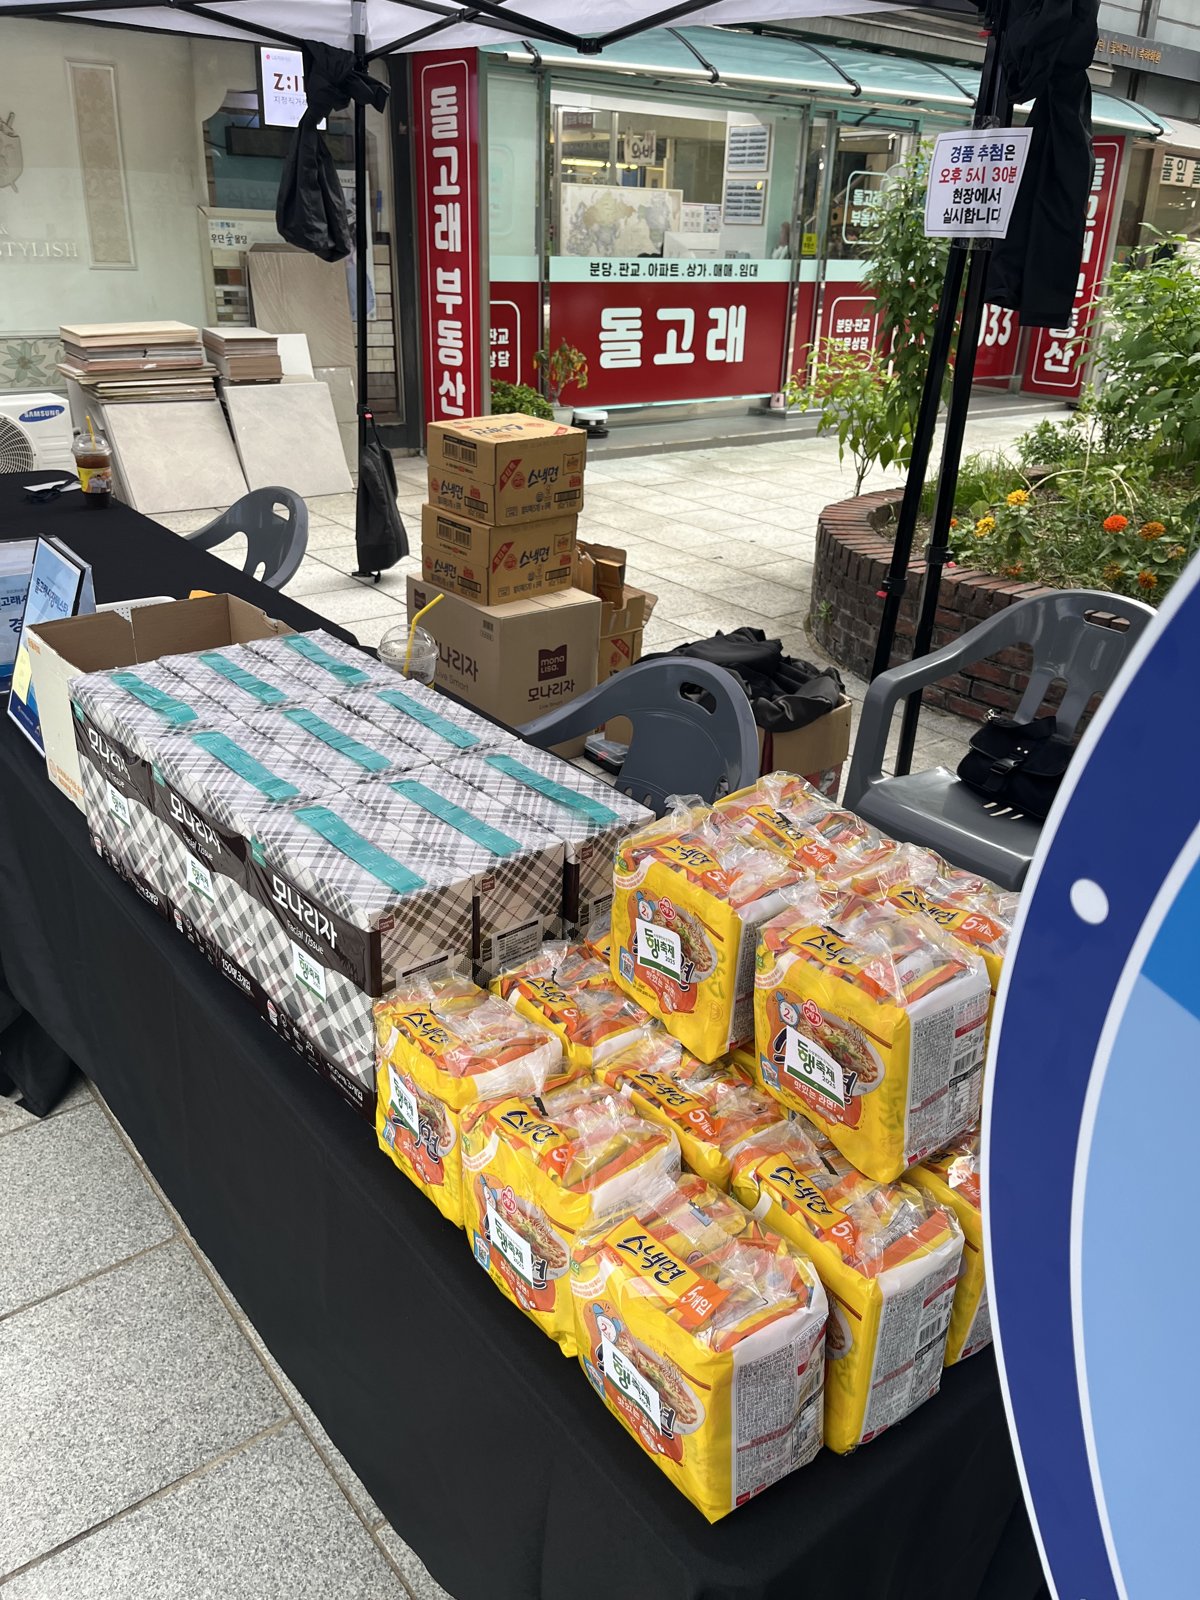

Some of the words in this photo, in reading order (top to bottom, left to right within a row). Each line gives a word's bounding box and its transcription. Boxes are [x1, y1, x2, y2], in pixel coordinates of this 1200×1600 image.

[951, 145, 974, 163] 경품
[977, 144, 1015, 162] 추첨은
[430, 84, 463, 253] 돌고래
[939, 167, 962, 184] 오후
[965, 166, 986, 184] 5시
[992, 166, 1018, 184] 30분
[952, 187, 1002, 205] 현장에서
[943, 207, 1002, 224] 실시합니다
[436, 266, 466, 417] 부동산
[599, 305, 746, 369] 돌고래
[24, 409, 60, 418] SAMSUNG
[441, 480, 464, 500] 스낵면
[528, 466, 559, 488] 스낵면
[434, 559, 457, 579] 스낵면
[519, 546, 550, 568] 스낵면
[434, 640, 478, 682] 나리자
[528, 680, 575, 702] 모나리자
[88, 727, 131, 780] 모나리자
[171, 792, 221, 854] 모나리자
[272, 873, 338, 949] 모나리자
[287, 919, 304, 940] Facial
[304, 932, 324, 955] Tissue
[665, 955, 676, 966] 2025
[635, 1073, 692, 1107] 스낵면
[793, 1080, 816, 1100] 맛있는
[822, 1076, 836, 1090] 2025
[500, 1110, 559, 1144] 스낵면
[769, 1166, 833, 1215] 스낵면
[616, 1235, 687, 1286] 스낵면
[681, 1285, 713, 1317] 5개입
